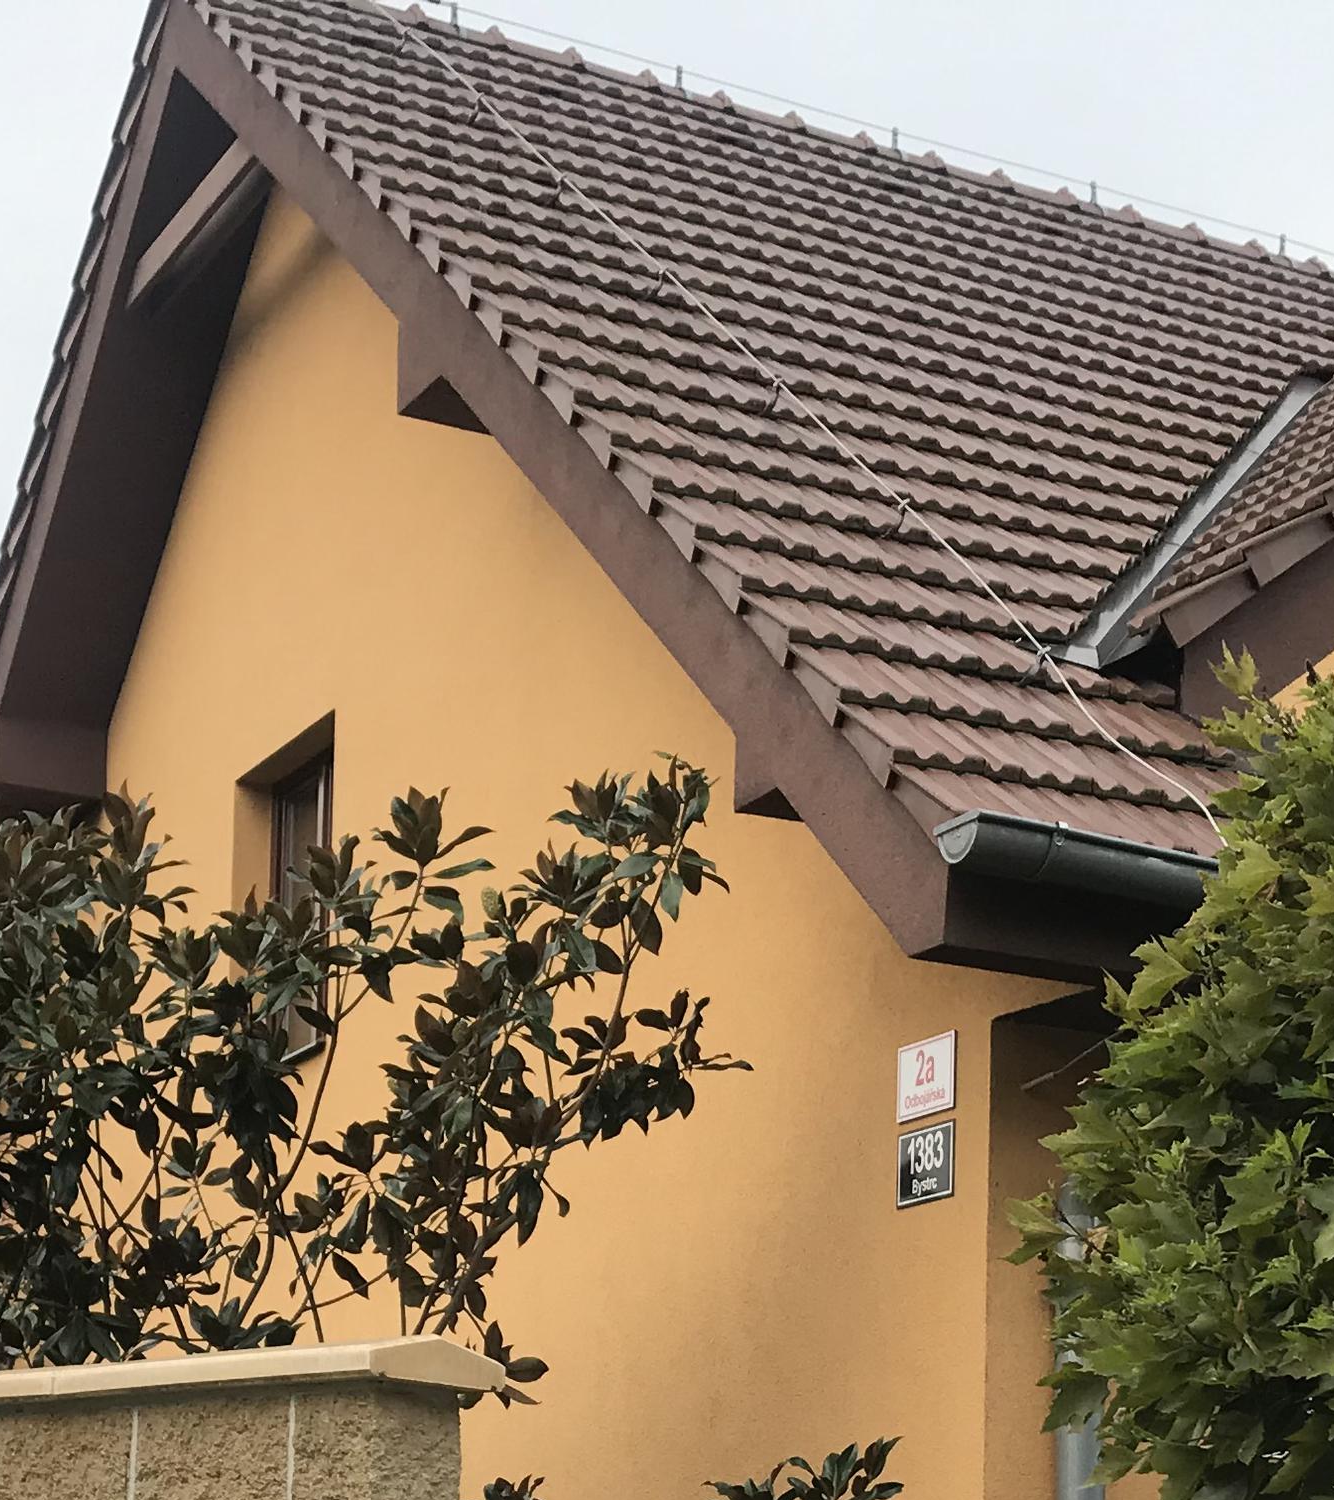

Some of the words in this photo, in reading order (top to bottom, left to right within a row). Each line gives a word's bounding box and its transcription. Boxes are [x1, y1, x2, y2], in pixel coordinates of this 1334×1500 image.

[915, 1049, 935, 1087] 2a
[907, 1130, 944, 1175] 1383
[911, 1176, 938, 1196] Bystrc
